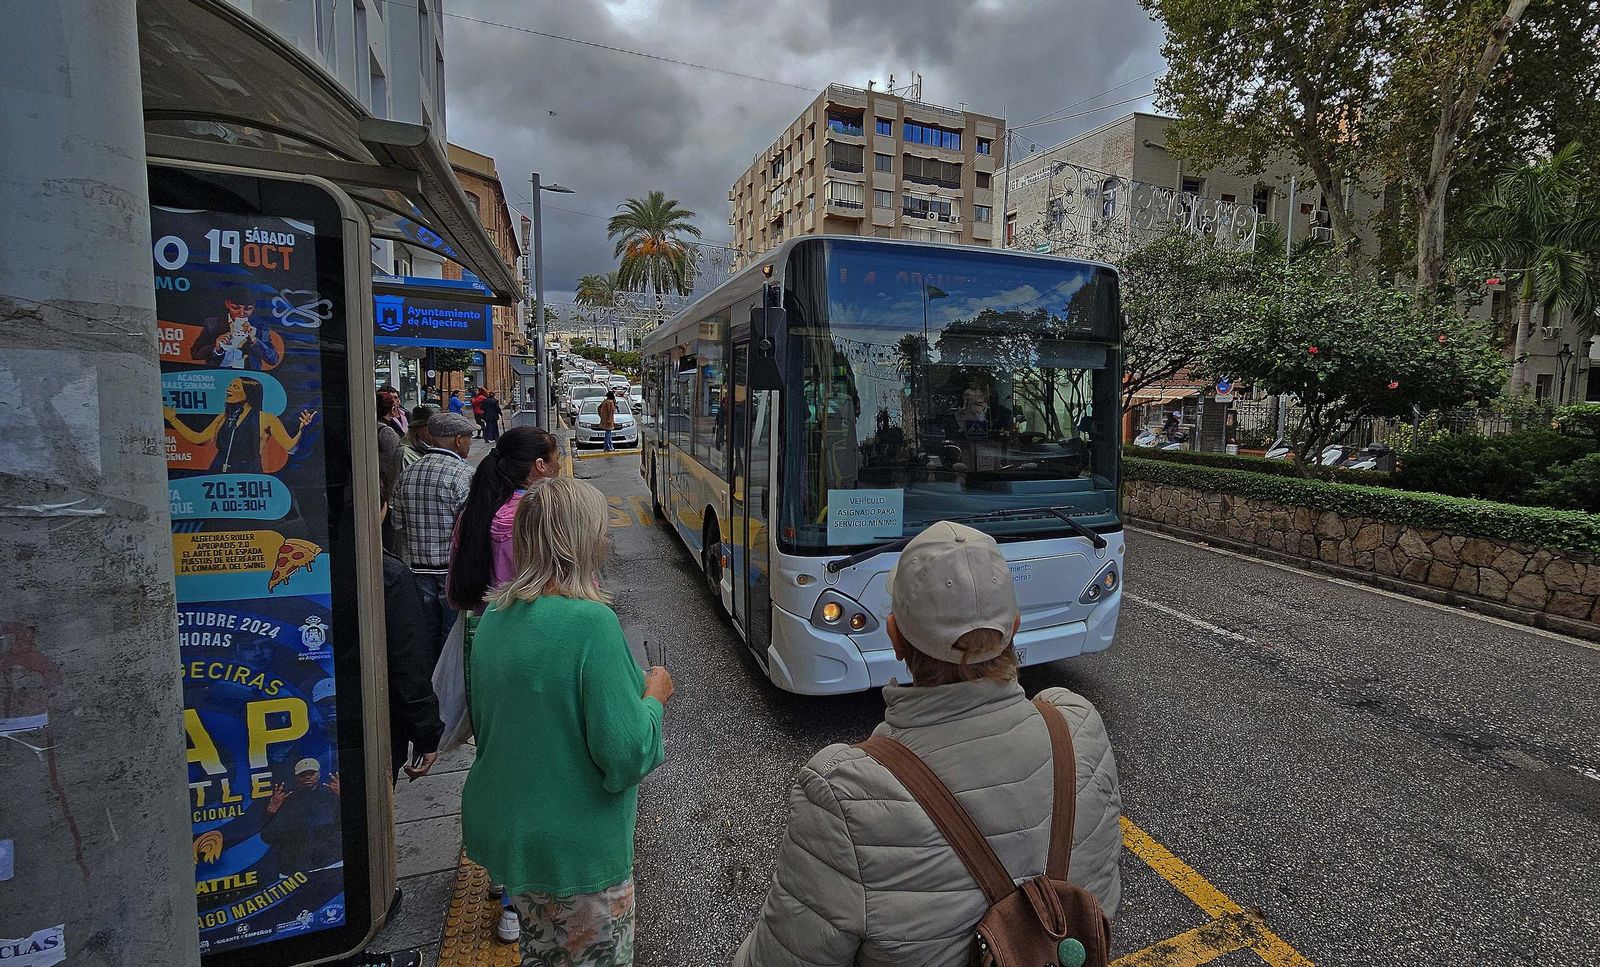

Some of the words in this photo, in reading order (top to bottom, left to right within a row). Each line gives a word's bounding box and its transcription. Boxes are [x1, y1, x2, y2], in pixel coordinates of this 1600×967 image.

[204, 229, 240, 264] 19
[245, 226, 296, 246] SÁBADO
[243, 243, 294, 271] OCT
[407, 305, 481, 319] Ayuntamiento
[407, 317, 420, 326] de
[421, 316, 469, 329] Algeciras
[177, 374, 215, 382] ACADEMIA
[201, 481, 273, 500] 20:30H
[211, 501, 219, 512] A
[222, 500, 267, 512] 00:30H
[849, 496, 885, 505] VEHÍCULO
[834, 520, 867, 528] SERVICIO
[868, 518, 897, 526] MÍNIMO
[191, 535, 229, 543] ALGECIRAS
[182, 557, 213, 565] PUESTOS
[226, 555, 264, 563] RECREARTE
[192, 564, 227, 572] COMARCA
[240, 616, 282, 640] 2024
[179, 632, 232, 647] HORAS
[193, 804, 245, 823] CIONAL
[195, 870, 258, 896] ATTLE
[230, 871, 309, 920] MARÍTIMO
